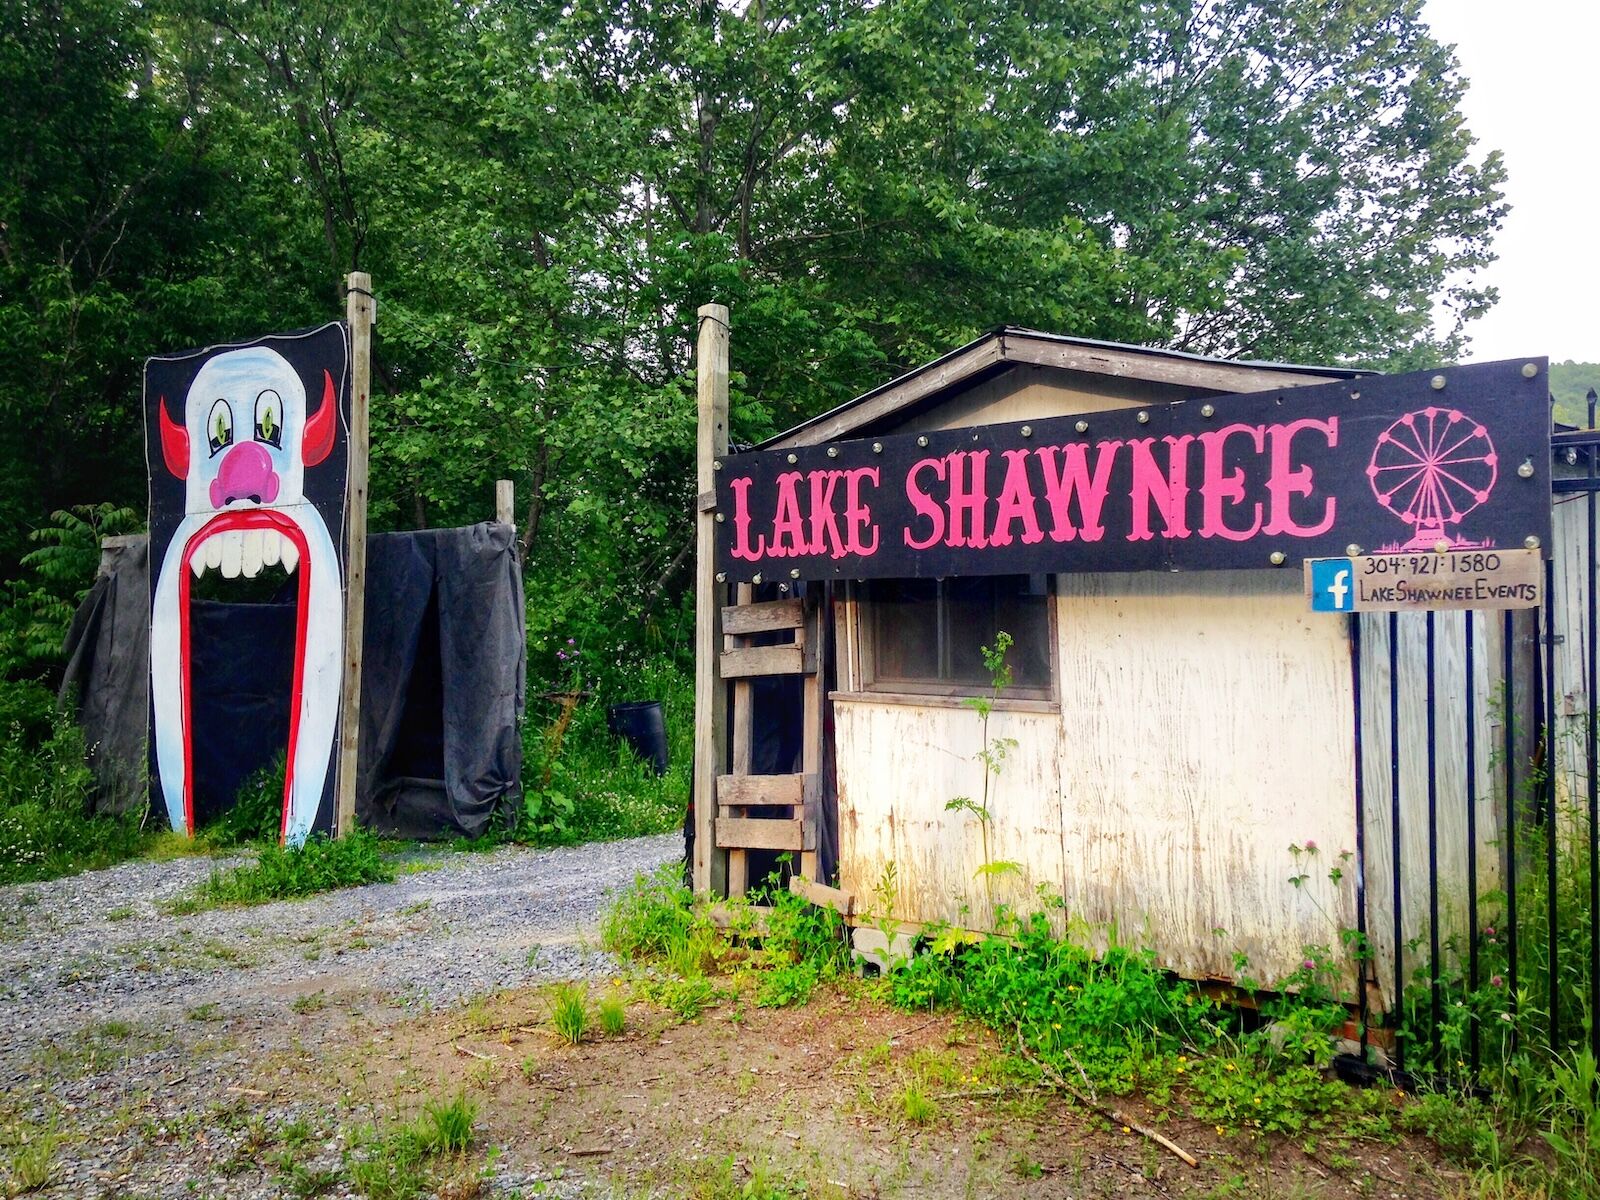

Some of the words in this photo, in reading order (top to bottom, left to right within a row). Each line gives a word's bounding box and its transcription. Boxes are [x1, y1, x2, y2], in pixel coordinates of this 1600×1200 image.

[730, 466, 880, 562] LAKE
[904, 416, 1338, 550] SHAWNEE
[1327, 570, 1349, 609] f
